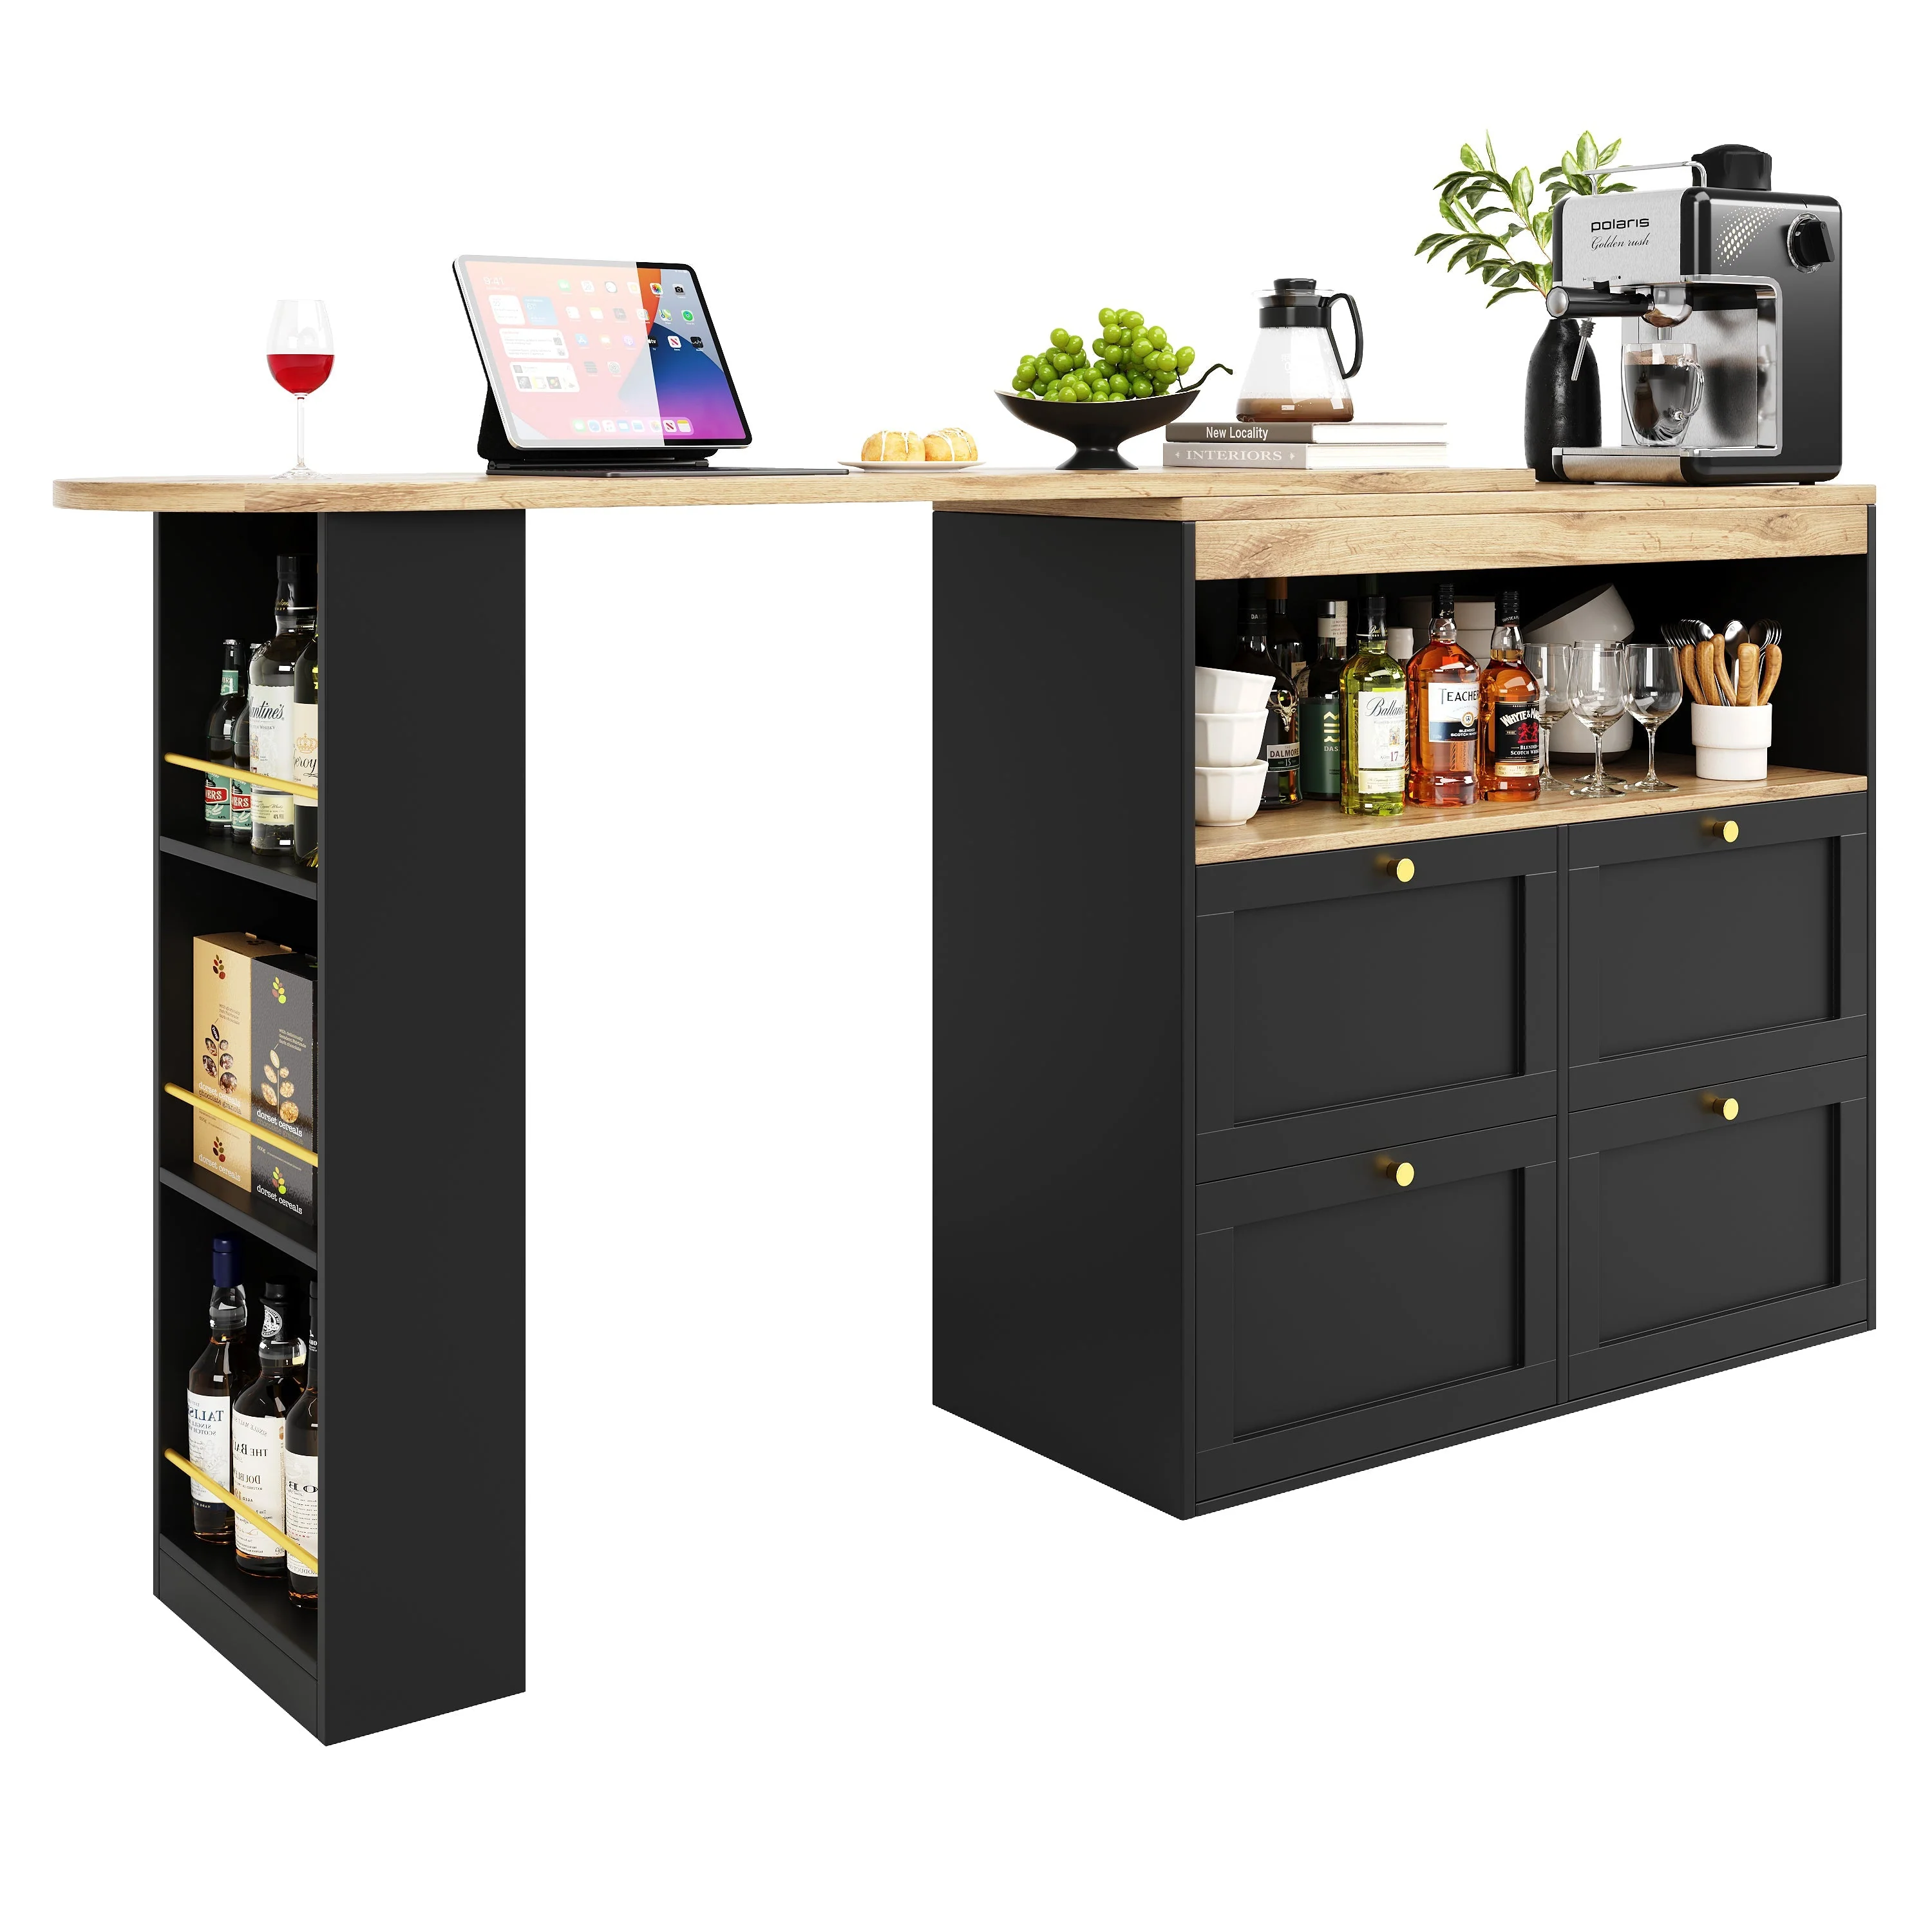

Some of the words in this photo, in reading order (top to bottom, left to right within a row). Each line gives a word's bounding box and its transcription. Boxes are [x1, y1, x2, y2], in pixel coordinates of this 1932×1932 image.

[1591, 218, 1649, 232] polaris
[1591, 234, 1624, 251] Golden
[1628, 232, 1651, 246] rush
[1206, 426, 1226, 439] New
[1229, 426, 1269, 441] Locality
[1186, 450, 1282, 461] INTERIORS
[1499, 710, 1528, 727] WHYTE
[1270, 748, 1299, 758] DALMORE
[1285, 758, 1291, 766] 15
[1391, 751, 1399, 762] 17
[198, 1082, 218, 1096] dorset
[218, 1092, 241, 1108] cereals
[198, 1090, 222, 1105] chocolate
[222, 1101, 242, 1115] granola
[256, 1109, 278, 1125] dorset
[278, 1121, 303, 1137] cereals
[257, 1118, 281, 1134] chocolate
[282, 1130, 303, 1145] granola
[198, 1153, 218, 1170] dorset
[218, 1165, 241, 1182] cereals
[256, 1184, 278, 1202] dorset
[278, 1197, 303, 1215] cereals
